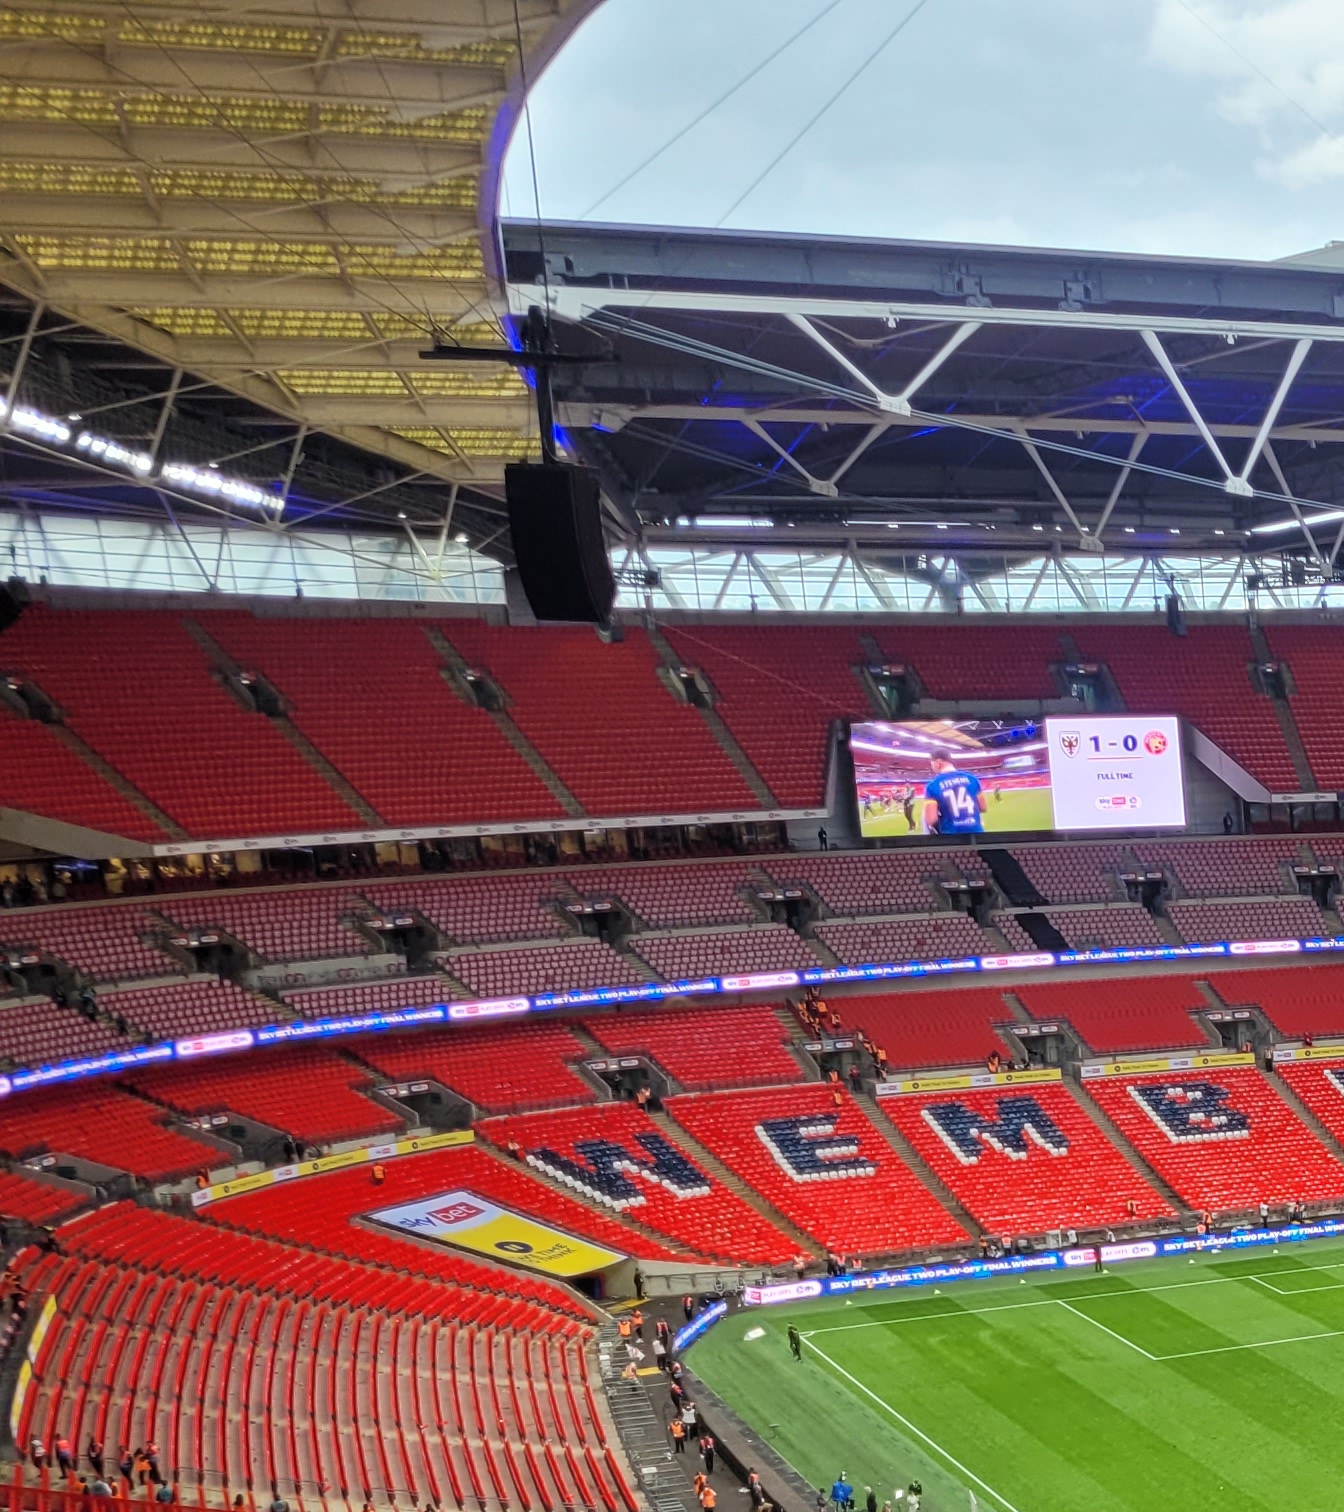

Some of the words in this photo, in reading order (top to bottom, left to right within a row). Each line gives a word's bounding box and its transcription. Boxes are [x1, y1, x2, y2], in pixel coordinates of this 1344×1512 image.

[1089, 735, 1101, 752] 1
[1123, 734, 1138, 752] 0
[943, 787, 974, 817] 14
[439, 1201, 477, 1223] bet
[1164, 1242, 1184, 1251] SKY
[1185, 1239, 1202, 1250] BET
[1203, 1236, 1235, 1249] LEAGUE
[1236, 1233, 1257, 1243] TWO
[1258, 1228, 1299, 1242] PLAY-OFF
[1300, 1225, 1322, 1237] FINAL
[830, 1279, 849, 1290] SKY
[849, 1277, 868, 1289] BET
[869, 1271, 911, 1287] LEAGUE
[912, 1269, 935, 1280] TWO
[936, 1264, 981, 1278] PLAY-OFF
[982, 1261, 1010, 1273] FINAL
[1011, 1256, 1057, 1271] WINNERS
